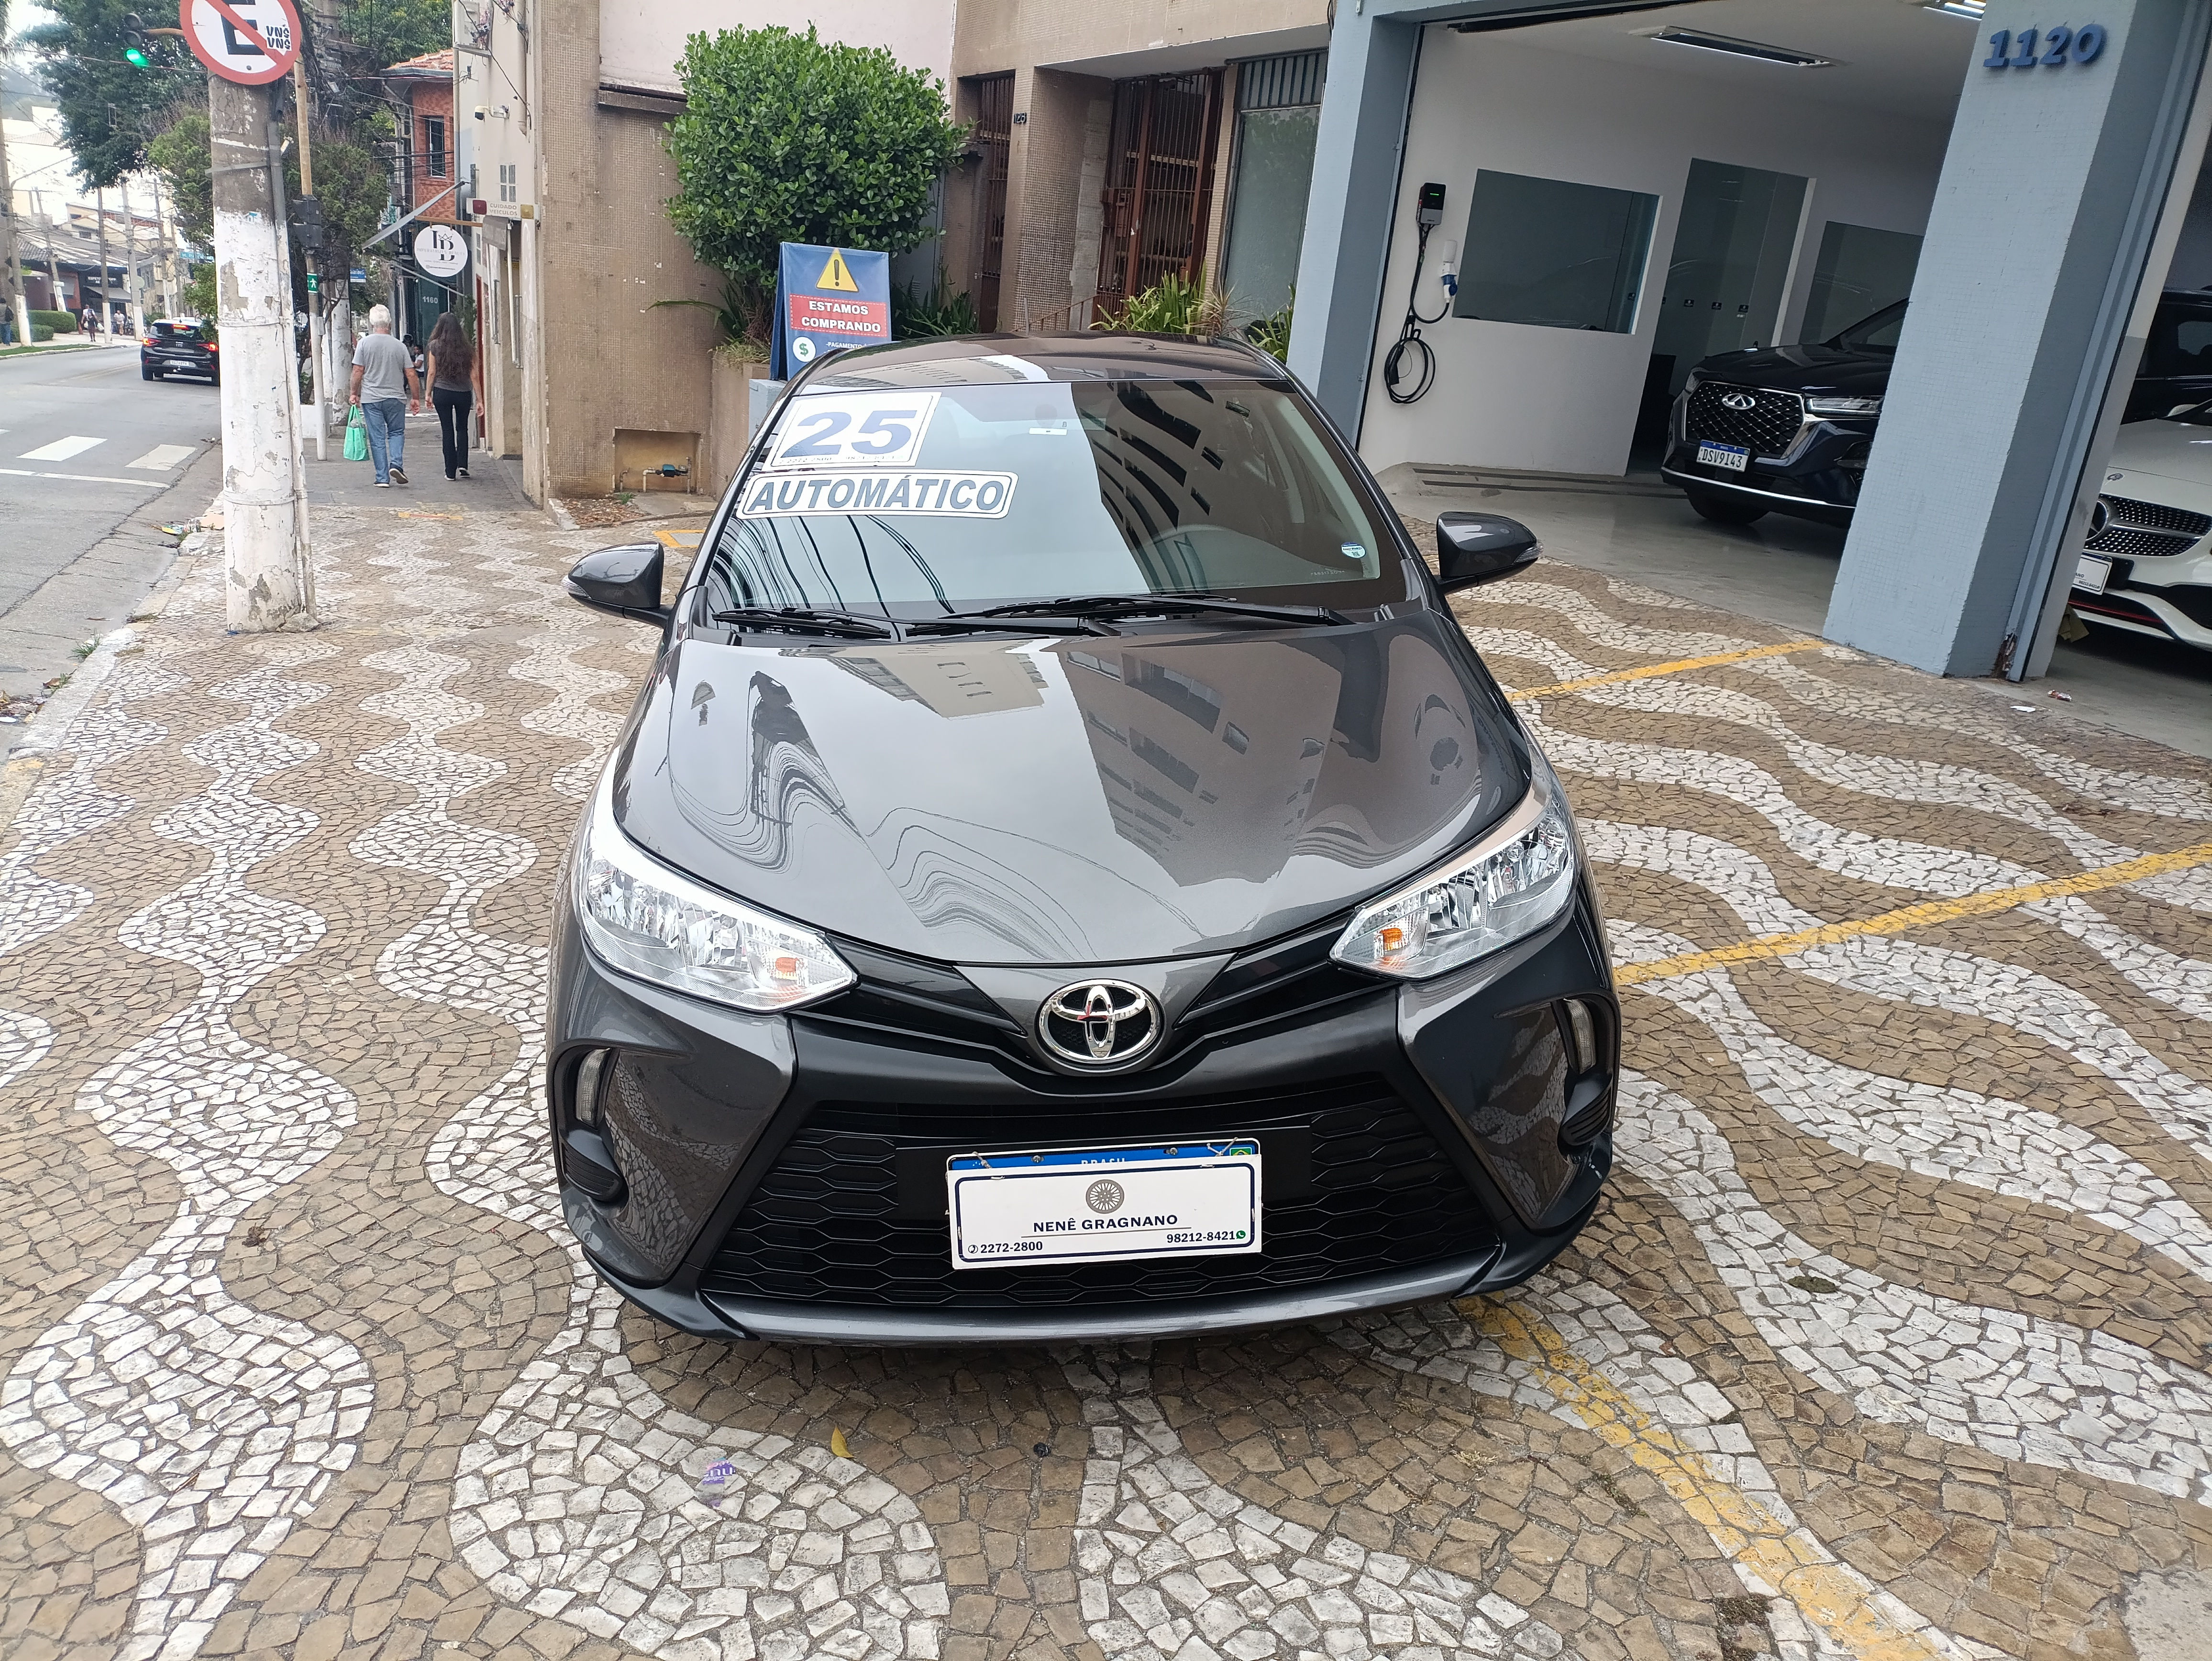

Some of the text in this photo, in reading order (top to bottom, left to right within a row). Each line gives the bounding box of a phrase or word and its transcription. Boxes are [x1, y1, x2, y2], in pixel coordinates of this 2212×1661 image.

[1983, 24, 2106, 67] 1120
[422, 296, 438, 304] 1160
[808, 300, 869, 315] ESTAMOS
[801, 316, 881, 332] COMPRANDO
[780, 410, 917, 458] 25
[748, 475, 1005, 511] AUTOMÁTICO
[1033, 1214, 1178, 1232] NENÊ GRAGNANO
[1166, 1230, 1236, 1243] 98212-8421
[980, 1241, 1043, 1254] 2272-2800
